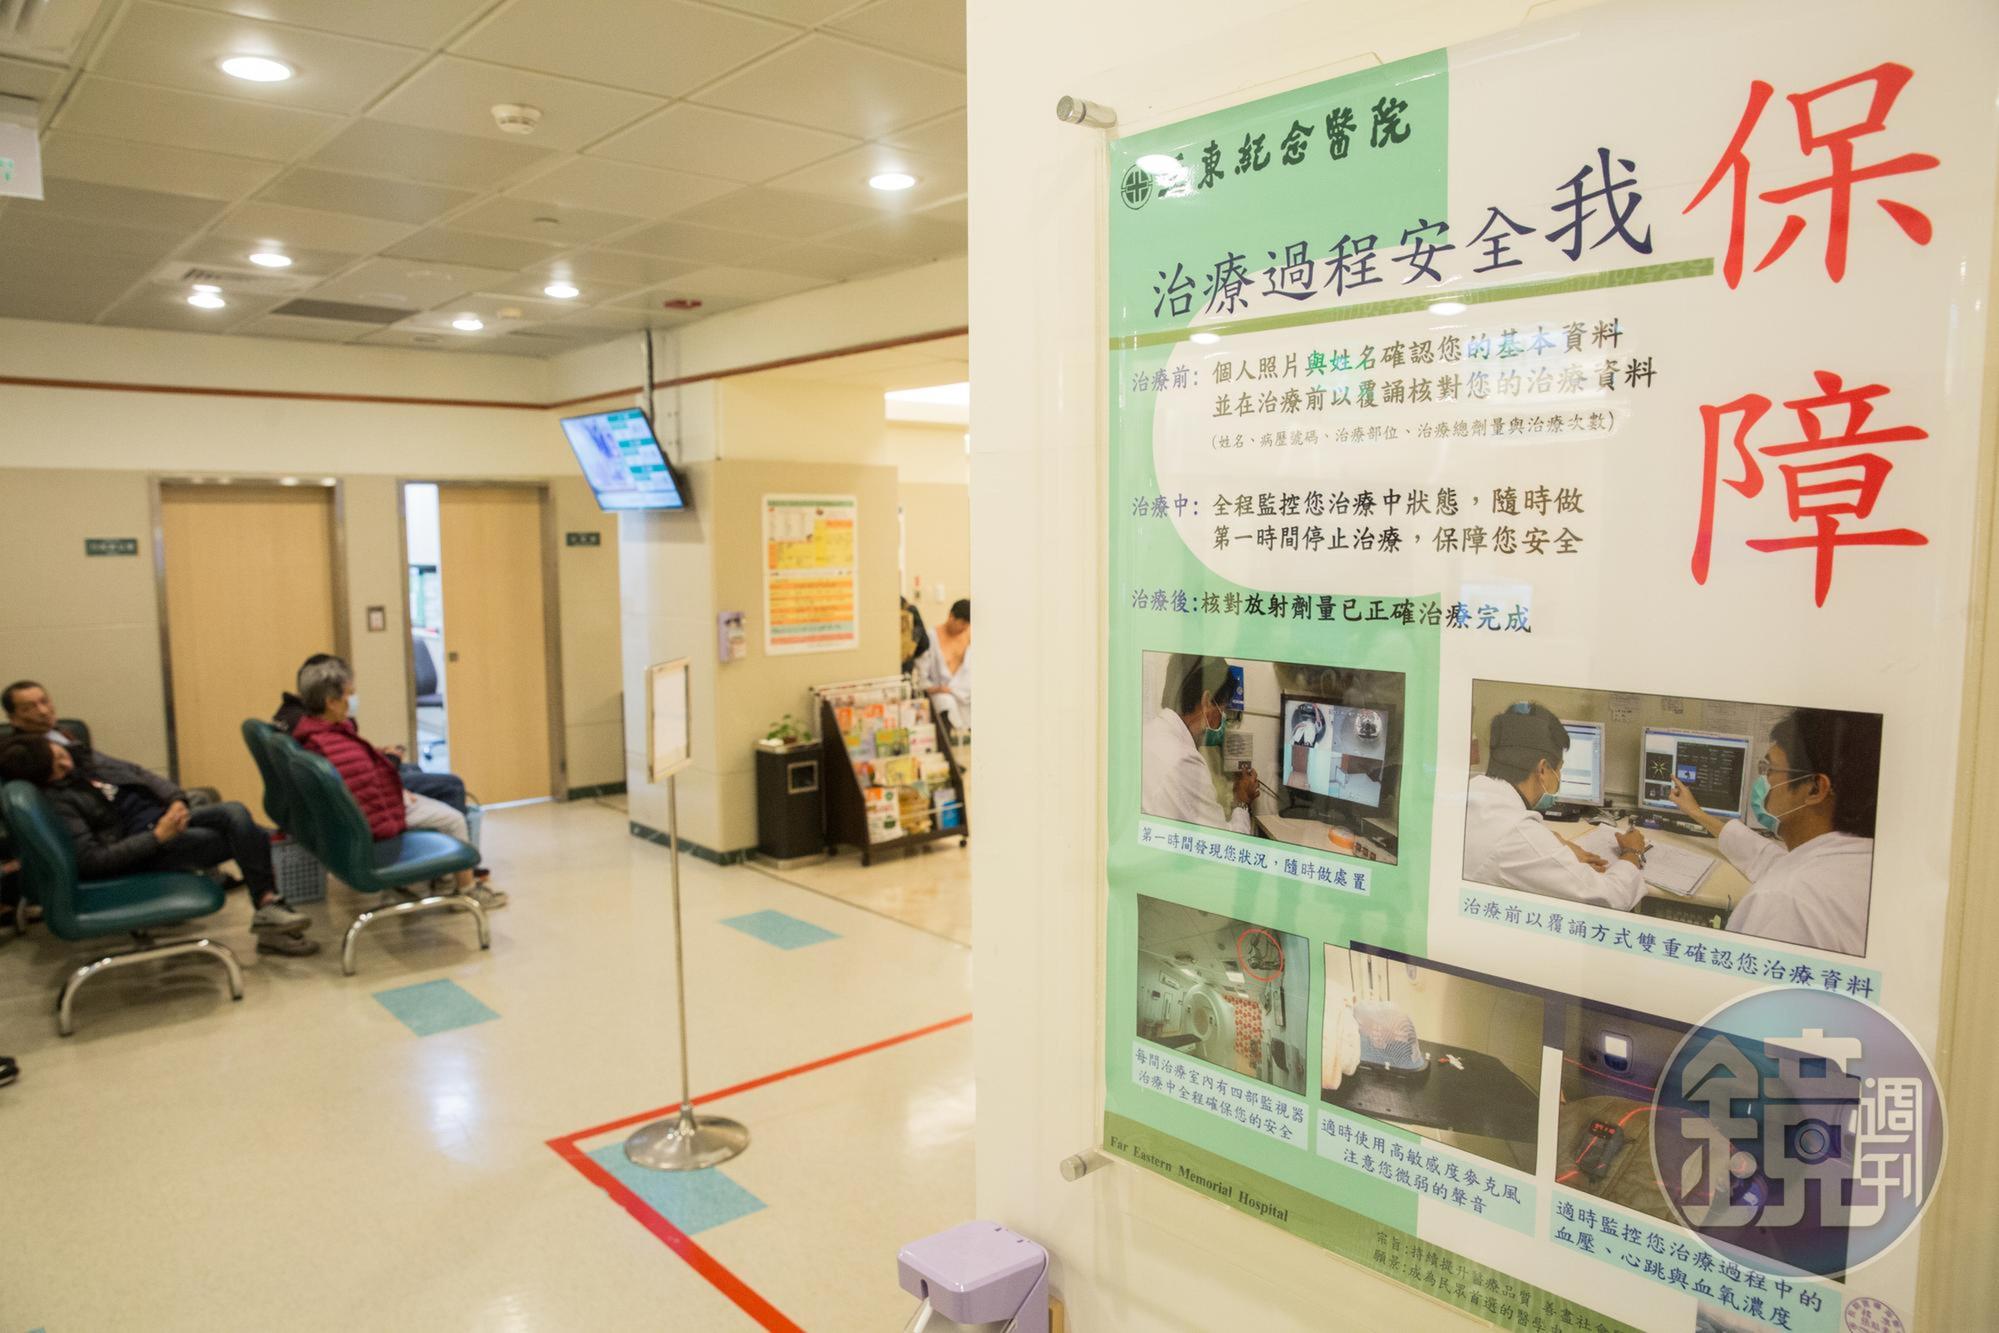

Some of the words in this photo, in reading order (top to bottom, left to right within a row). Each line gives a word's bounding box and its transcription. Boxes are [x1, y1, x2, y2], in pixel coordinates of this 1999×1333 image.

[1158, 97, 1411, 197] 東紀念醫院
[1153, 147, 1653, 318] 治療過程安全我
[1212, 318, 1623, 385] 個人照片與姓名確認您的基本資料
[1212, 356, 1658, 418] 並在治療前以覆誦核對您的治療資料
[1212, 485, 1585, 517] 全程監控您治療中狀態，隨時做
[1212, 525, 1584, 555] 第一時間停止治療，保障您安全
[1142, 826, 1366, 892] 第一時間發現您狀況，隨時做處置
[1462, 896, 1874, 999] 治療前以覆誦方式雙重確認您治療資料
[1138, 1069, 1293, 1140] 治療中全程確保您的安全
[1110, 1135, 1128, 1152] Far
[1133, 1145, 1172, 1172] Eastern
[1178, 1164, 1233, 1198] Memorial
[1238, 1190, 1288, 1222] Hospital
[1321, 1117, 1521, 1204] 適時使用高敏感度麥克風
[1344, 1148, 1487, 1214] 注意您微弱的聲音
[1554, 1226, 1792, 1332] 血壓、心跳與血氧濃度
[1555, 1200, 1823, 1312] 適時監控您治療過程中的
